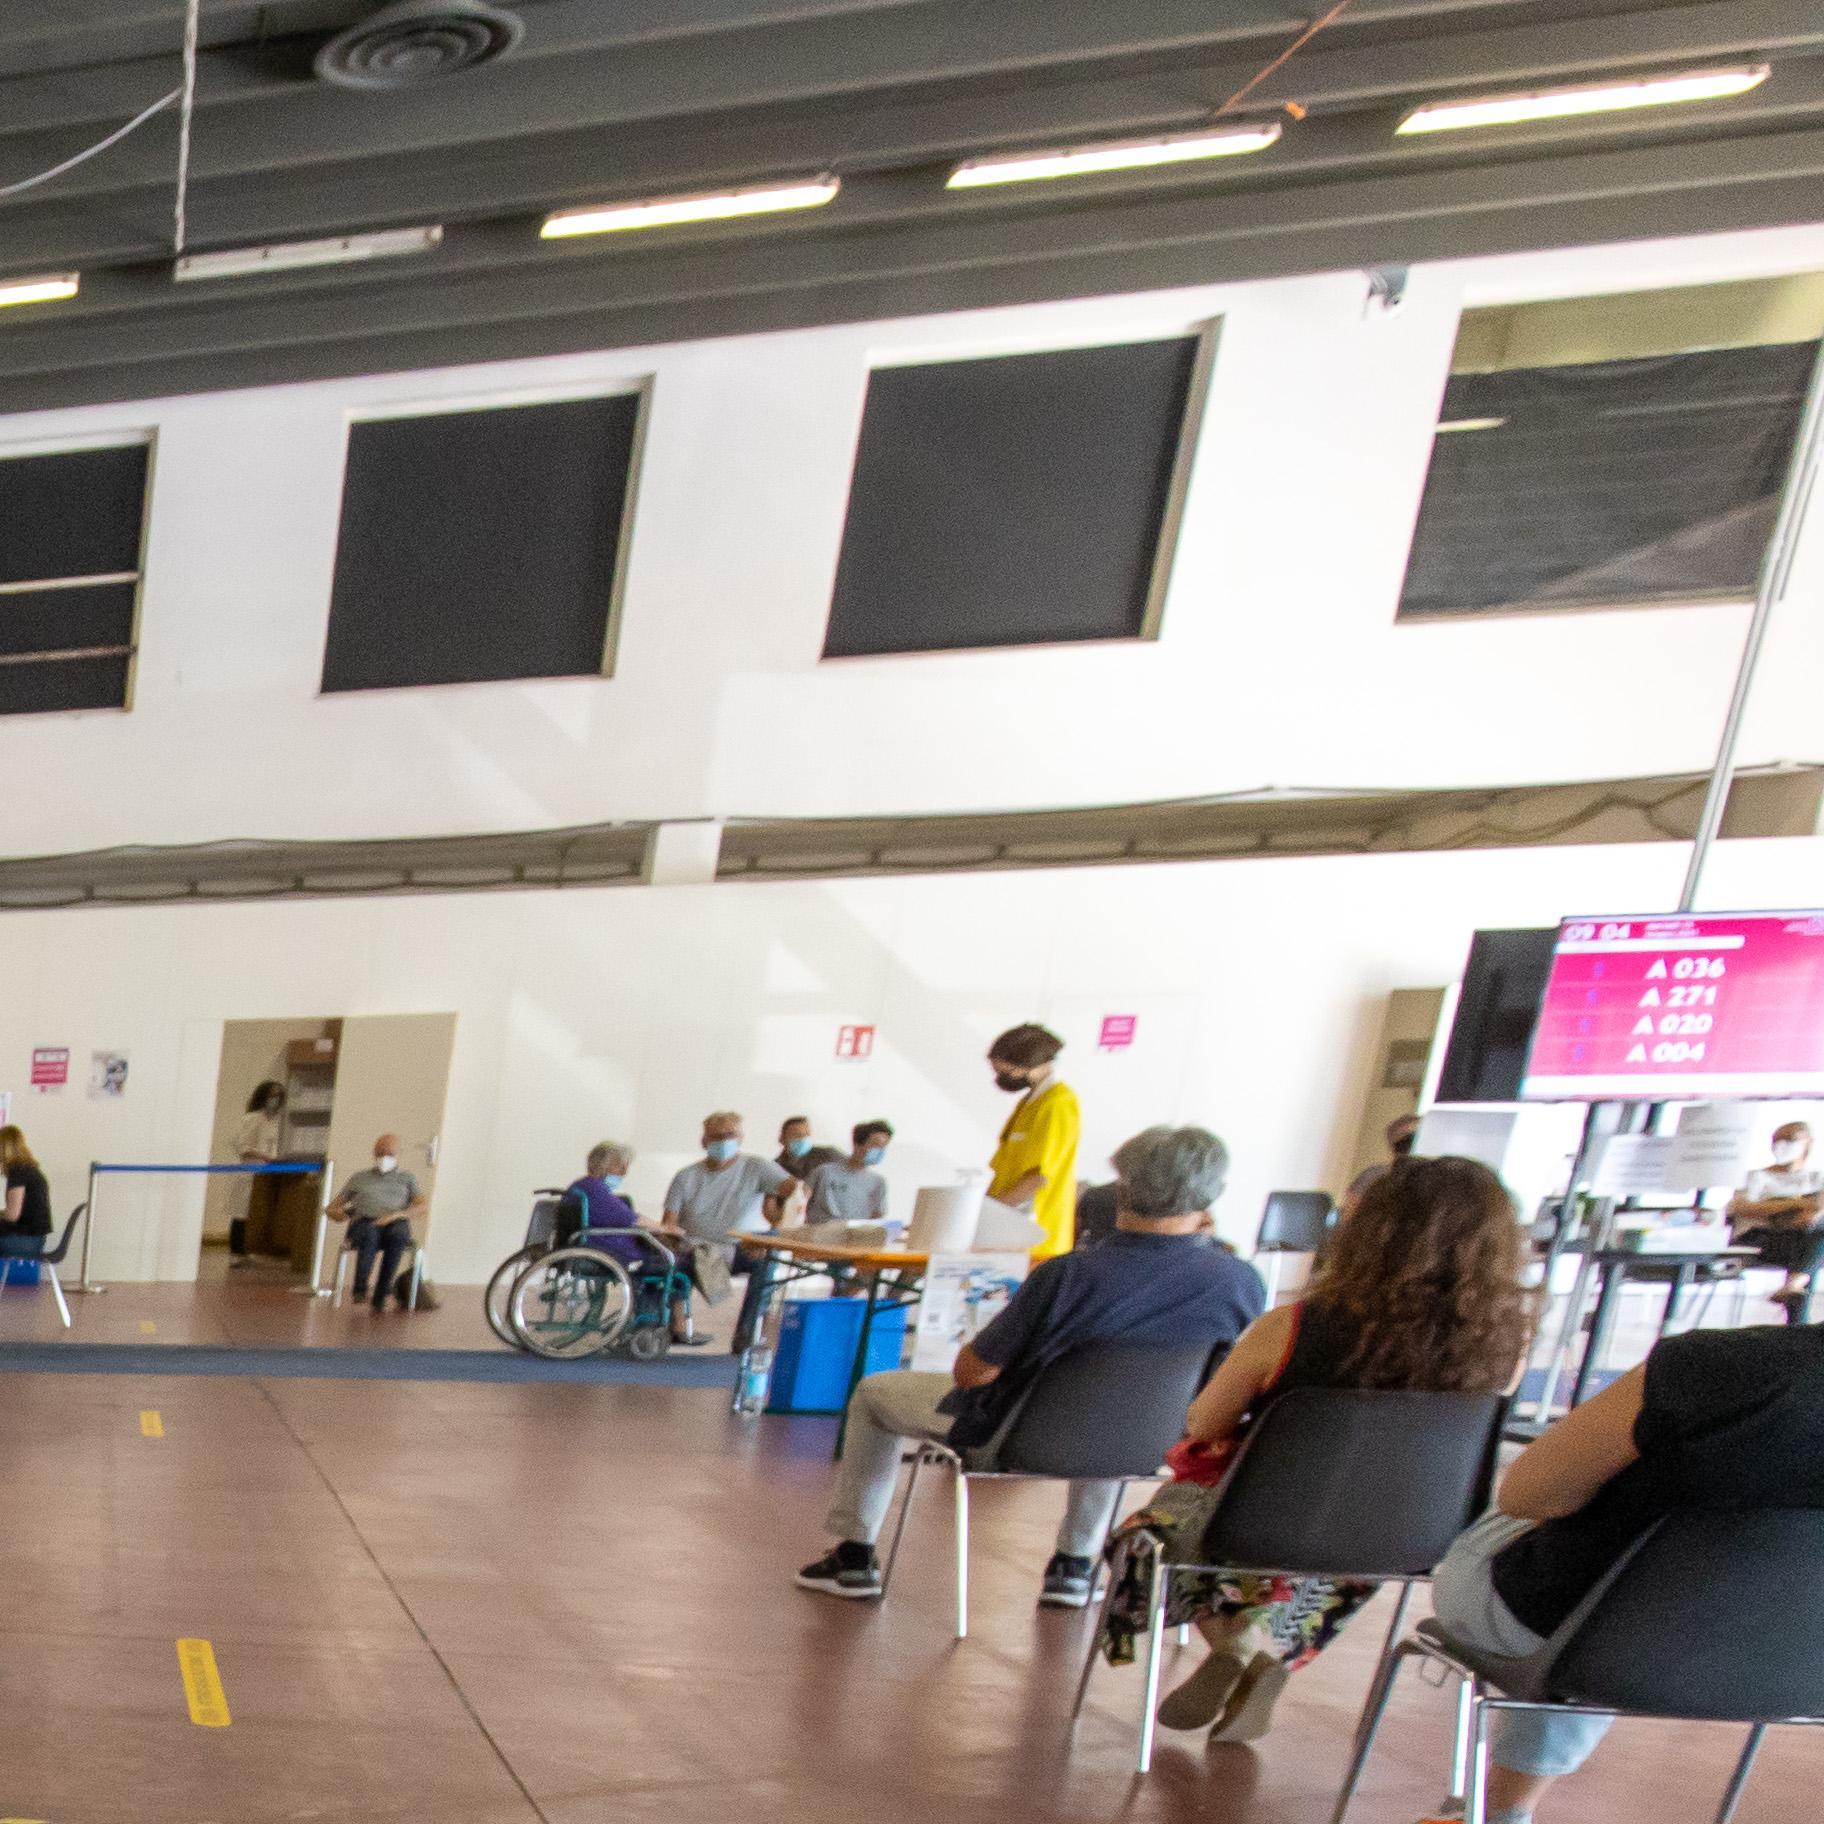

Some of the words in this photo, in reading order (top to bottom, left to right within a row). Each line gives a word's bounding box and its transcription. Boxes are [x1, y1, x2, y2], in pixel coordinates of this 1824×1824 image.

[1645, 957, 1668, 980] A
[1672, 957, 1727, 980] 036
[1638, 986, 1661, 1008] A
[1665, 985, 1718, 1008] 271
[1631, 1014, 1654, 1035] A
[1658, 1013, 1714, 1035] 020
[1625, 1042, 1647, 1063] A
